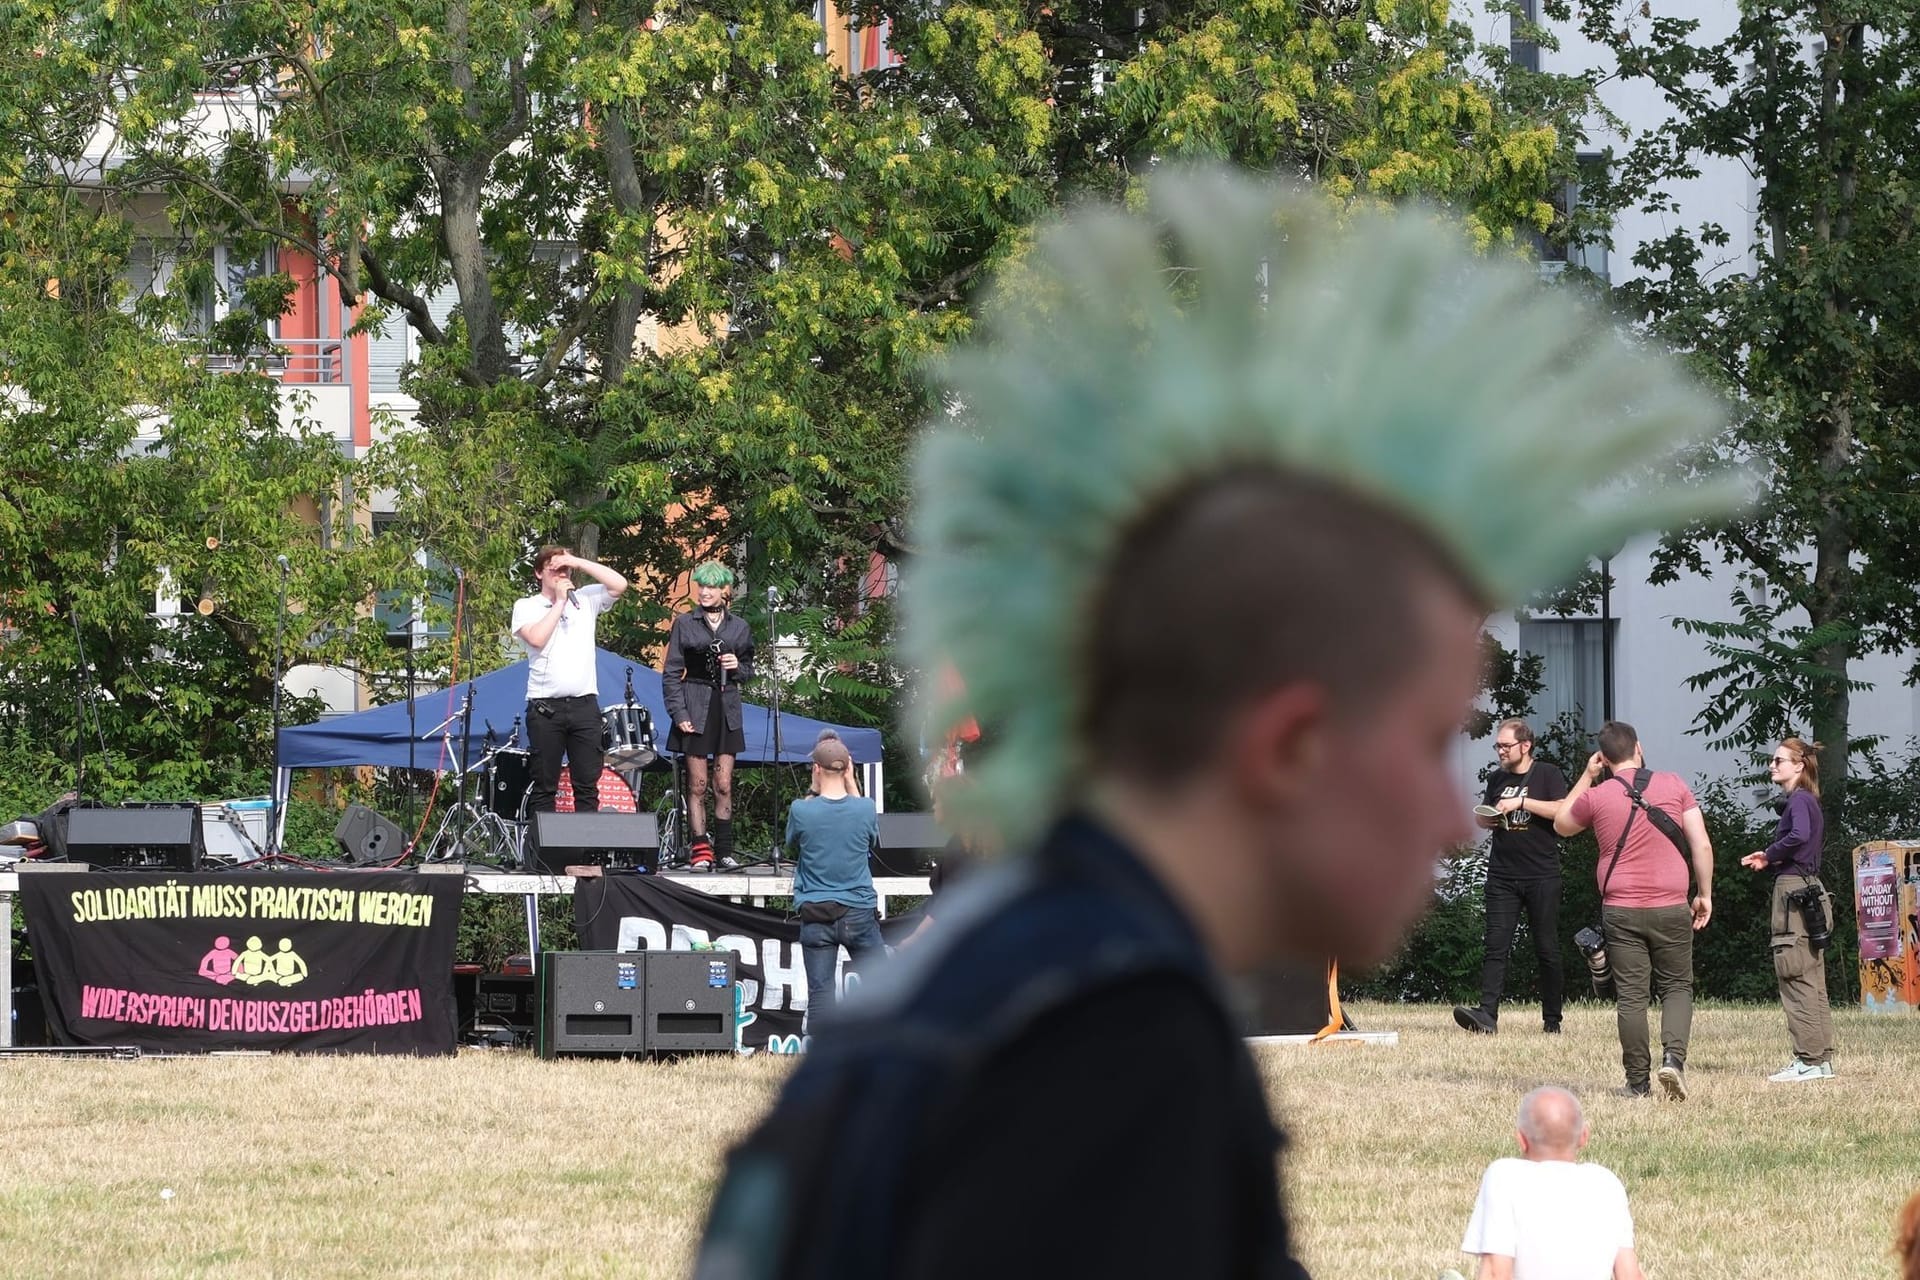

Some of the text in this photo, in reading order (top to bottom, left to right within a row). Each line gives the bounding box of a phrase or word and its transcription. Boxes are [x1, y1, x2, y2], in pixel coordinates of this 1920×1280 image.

[1862, 884, 1892, 896] MONDAY
[71, 880, 433, 926] SOLIDARITÄT MUSS PRAKTISCH WERDEN
[1861, 895, 1893, 907] WITHOUT
[1871, 906, 1885, 917] YOU
[82, 985, 205, 1027] WIDERSPRUCH
